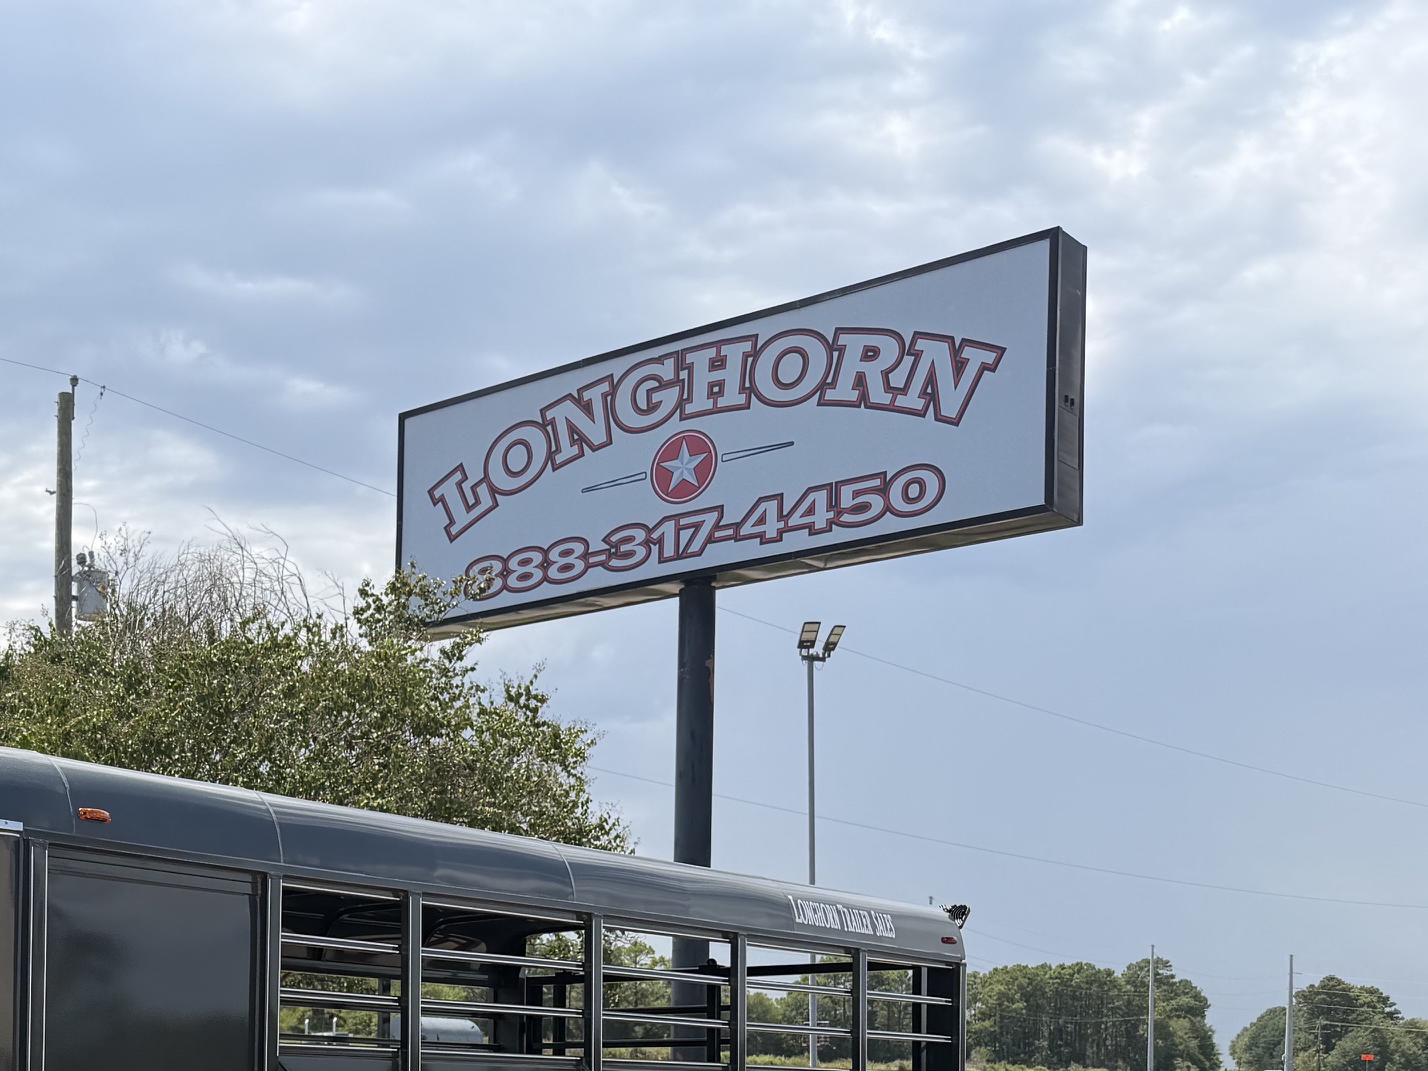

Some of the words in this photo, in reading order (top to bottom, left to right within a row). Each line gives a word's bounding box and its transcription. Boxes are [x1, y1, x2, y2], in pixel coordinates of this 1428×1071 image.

[428, 327, 1007, 543] LONGHORN
[464, 463, 946, 602] 888-317-4450
[787, 895, 840, 930] LONGHORN
[837, 904, 873, 934] TRAILER
[871, 910, 896, 938] SALES
